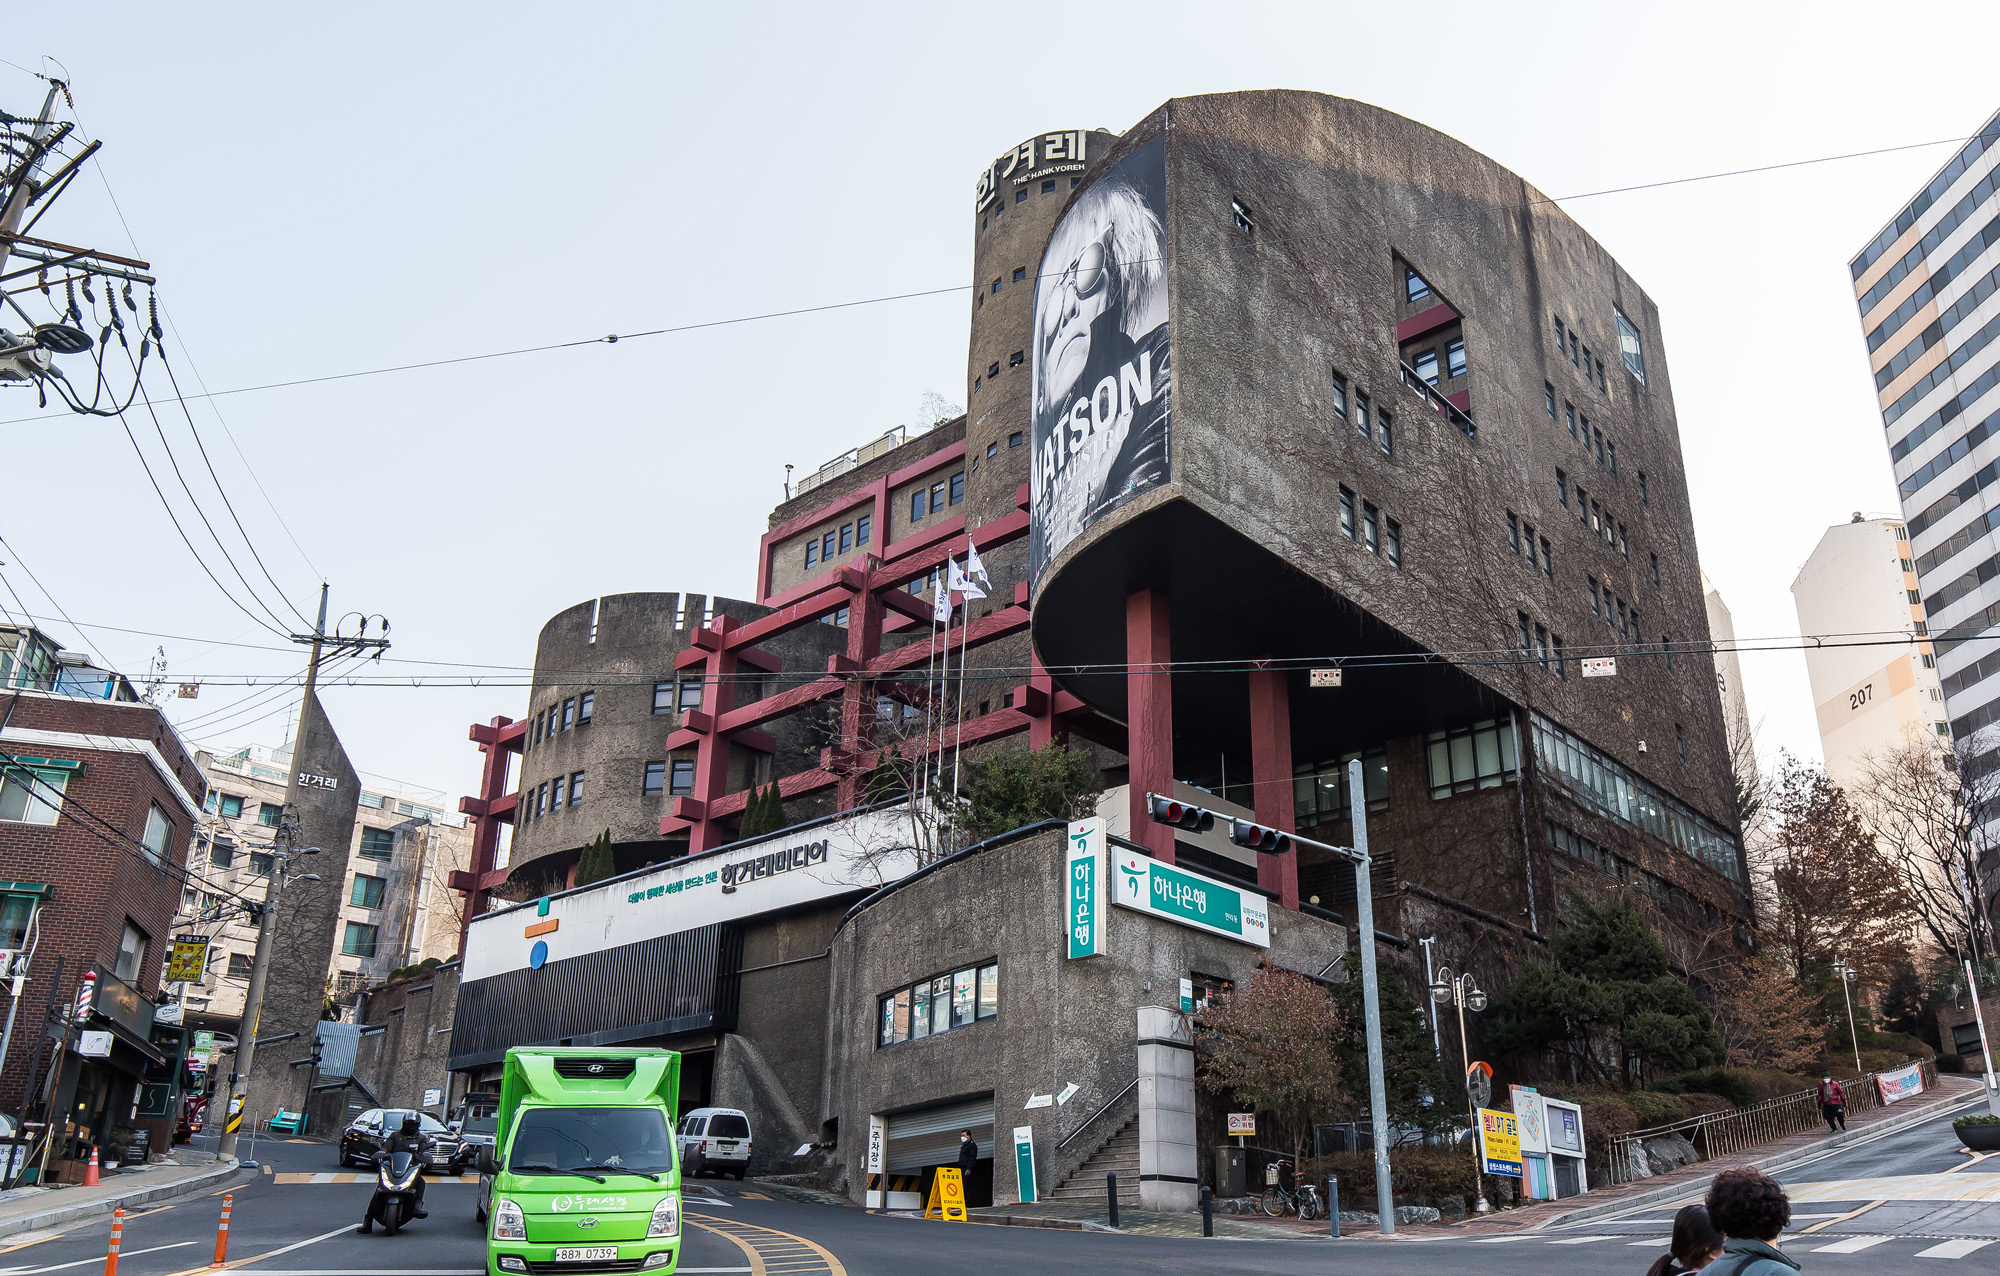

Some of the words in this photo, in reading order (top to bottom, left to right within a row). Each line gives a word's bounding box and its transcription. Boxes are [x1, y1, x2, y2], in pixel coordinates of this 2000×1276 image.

[976, 129, 1086, 213] 한겨레
[1012, 174, 1028, 186] THE
[1031, 163, 1085, 180] HANKYOREH
[1034, 486, 1051, 529] THE
[1052, 416, 1131, 506] MAESTRO
[1849, 683, 1873, 711] 207
[298, 772, 338, 789] 한겨레
[720, 839, 829, 895] 한겨레미디어
[665, 880, 684, 895] 세상을
[685, 875, 704, 890] 만드는
[705, 870, 718, 885] 언론
[1153, 874, 1207, 915] 하나은행
[1074, 862, 1091, 946] 하나은행
[1483, 1113, 1496, 1133] 헬스
[1495, 1116, 1505, 1135] PT
[1505, 1118, 1518, 1137] 골프
[870, 1131, 881, 1163] 주차장
[585, 1248, 612, 1259] 0739
